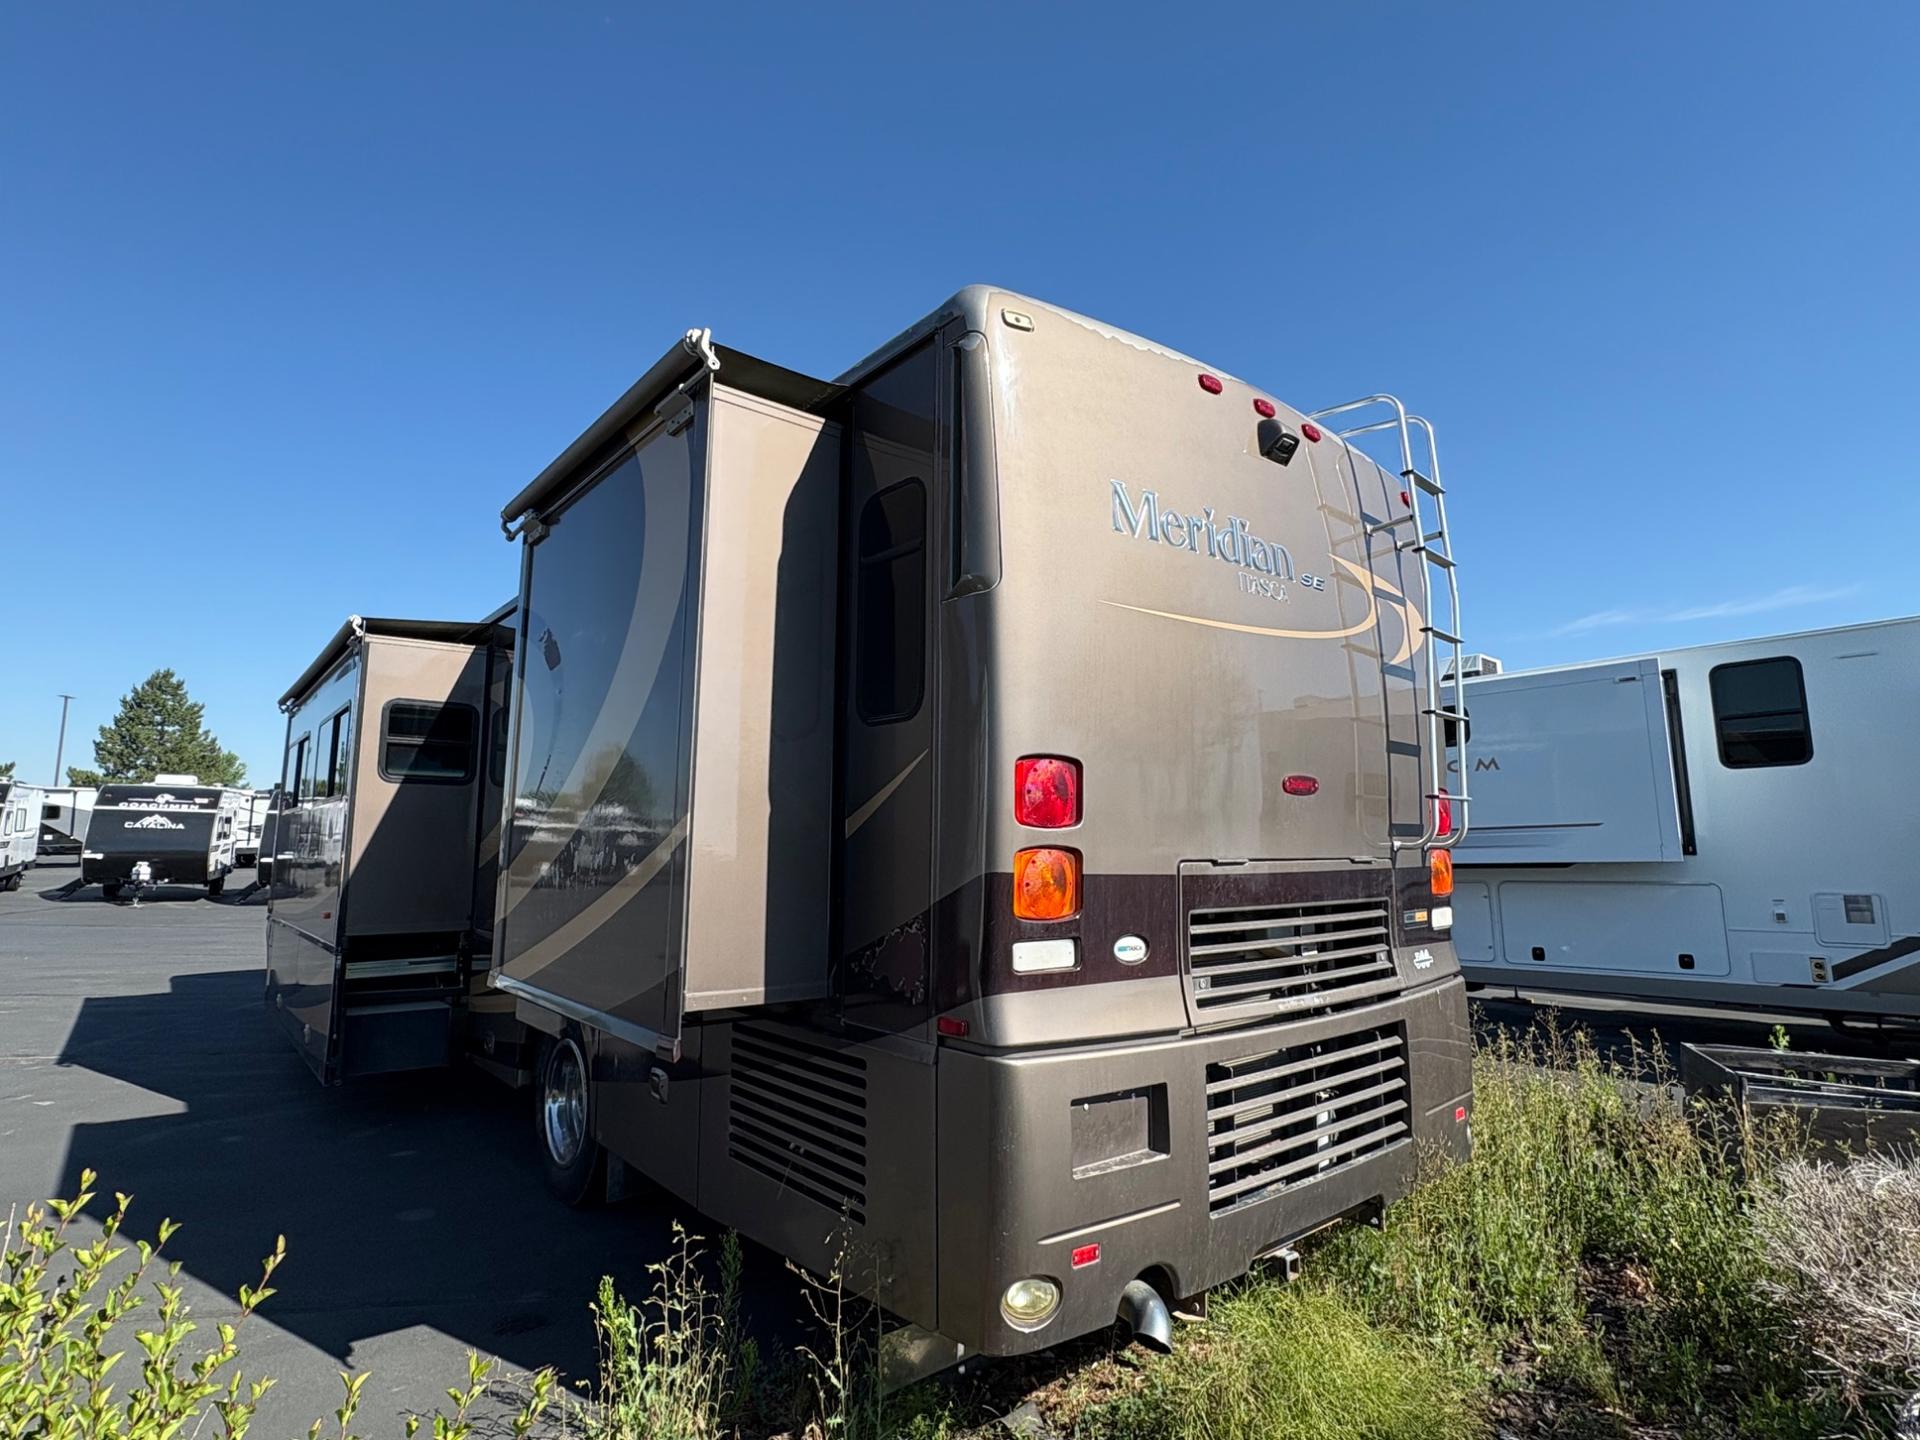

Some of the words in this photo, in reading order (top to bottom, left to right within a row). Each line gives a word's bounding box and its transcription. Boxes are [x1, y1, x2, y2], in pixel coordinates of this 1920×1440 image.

[1109, 478, 1297, 583] Meridian
[1300, 573, 1325, 592] SE
[1238, 571, 1291, 604] ITASCA
[118, 801, 200, 812] COACHMEN
[123, 819, 185, 830] CATALINA
